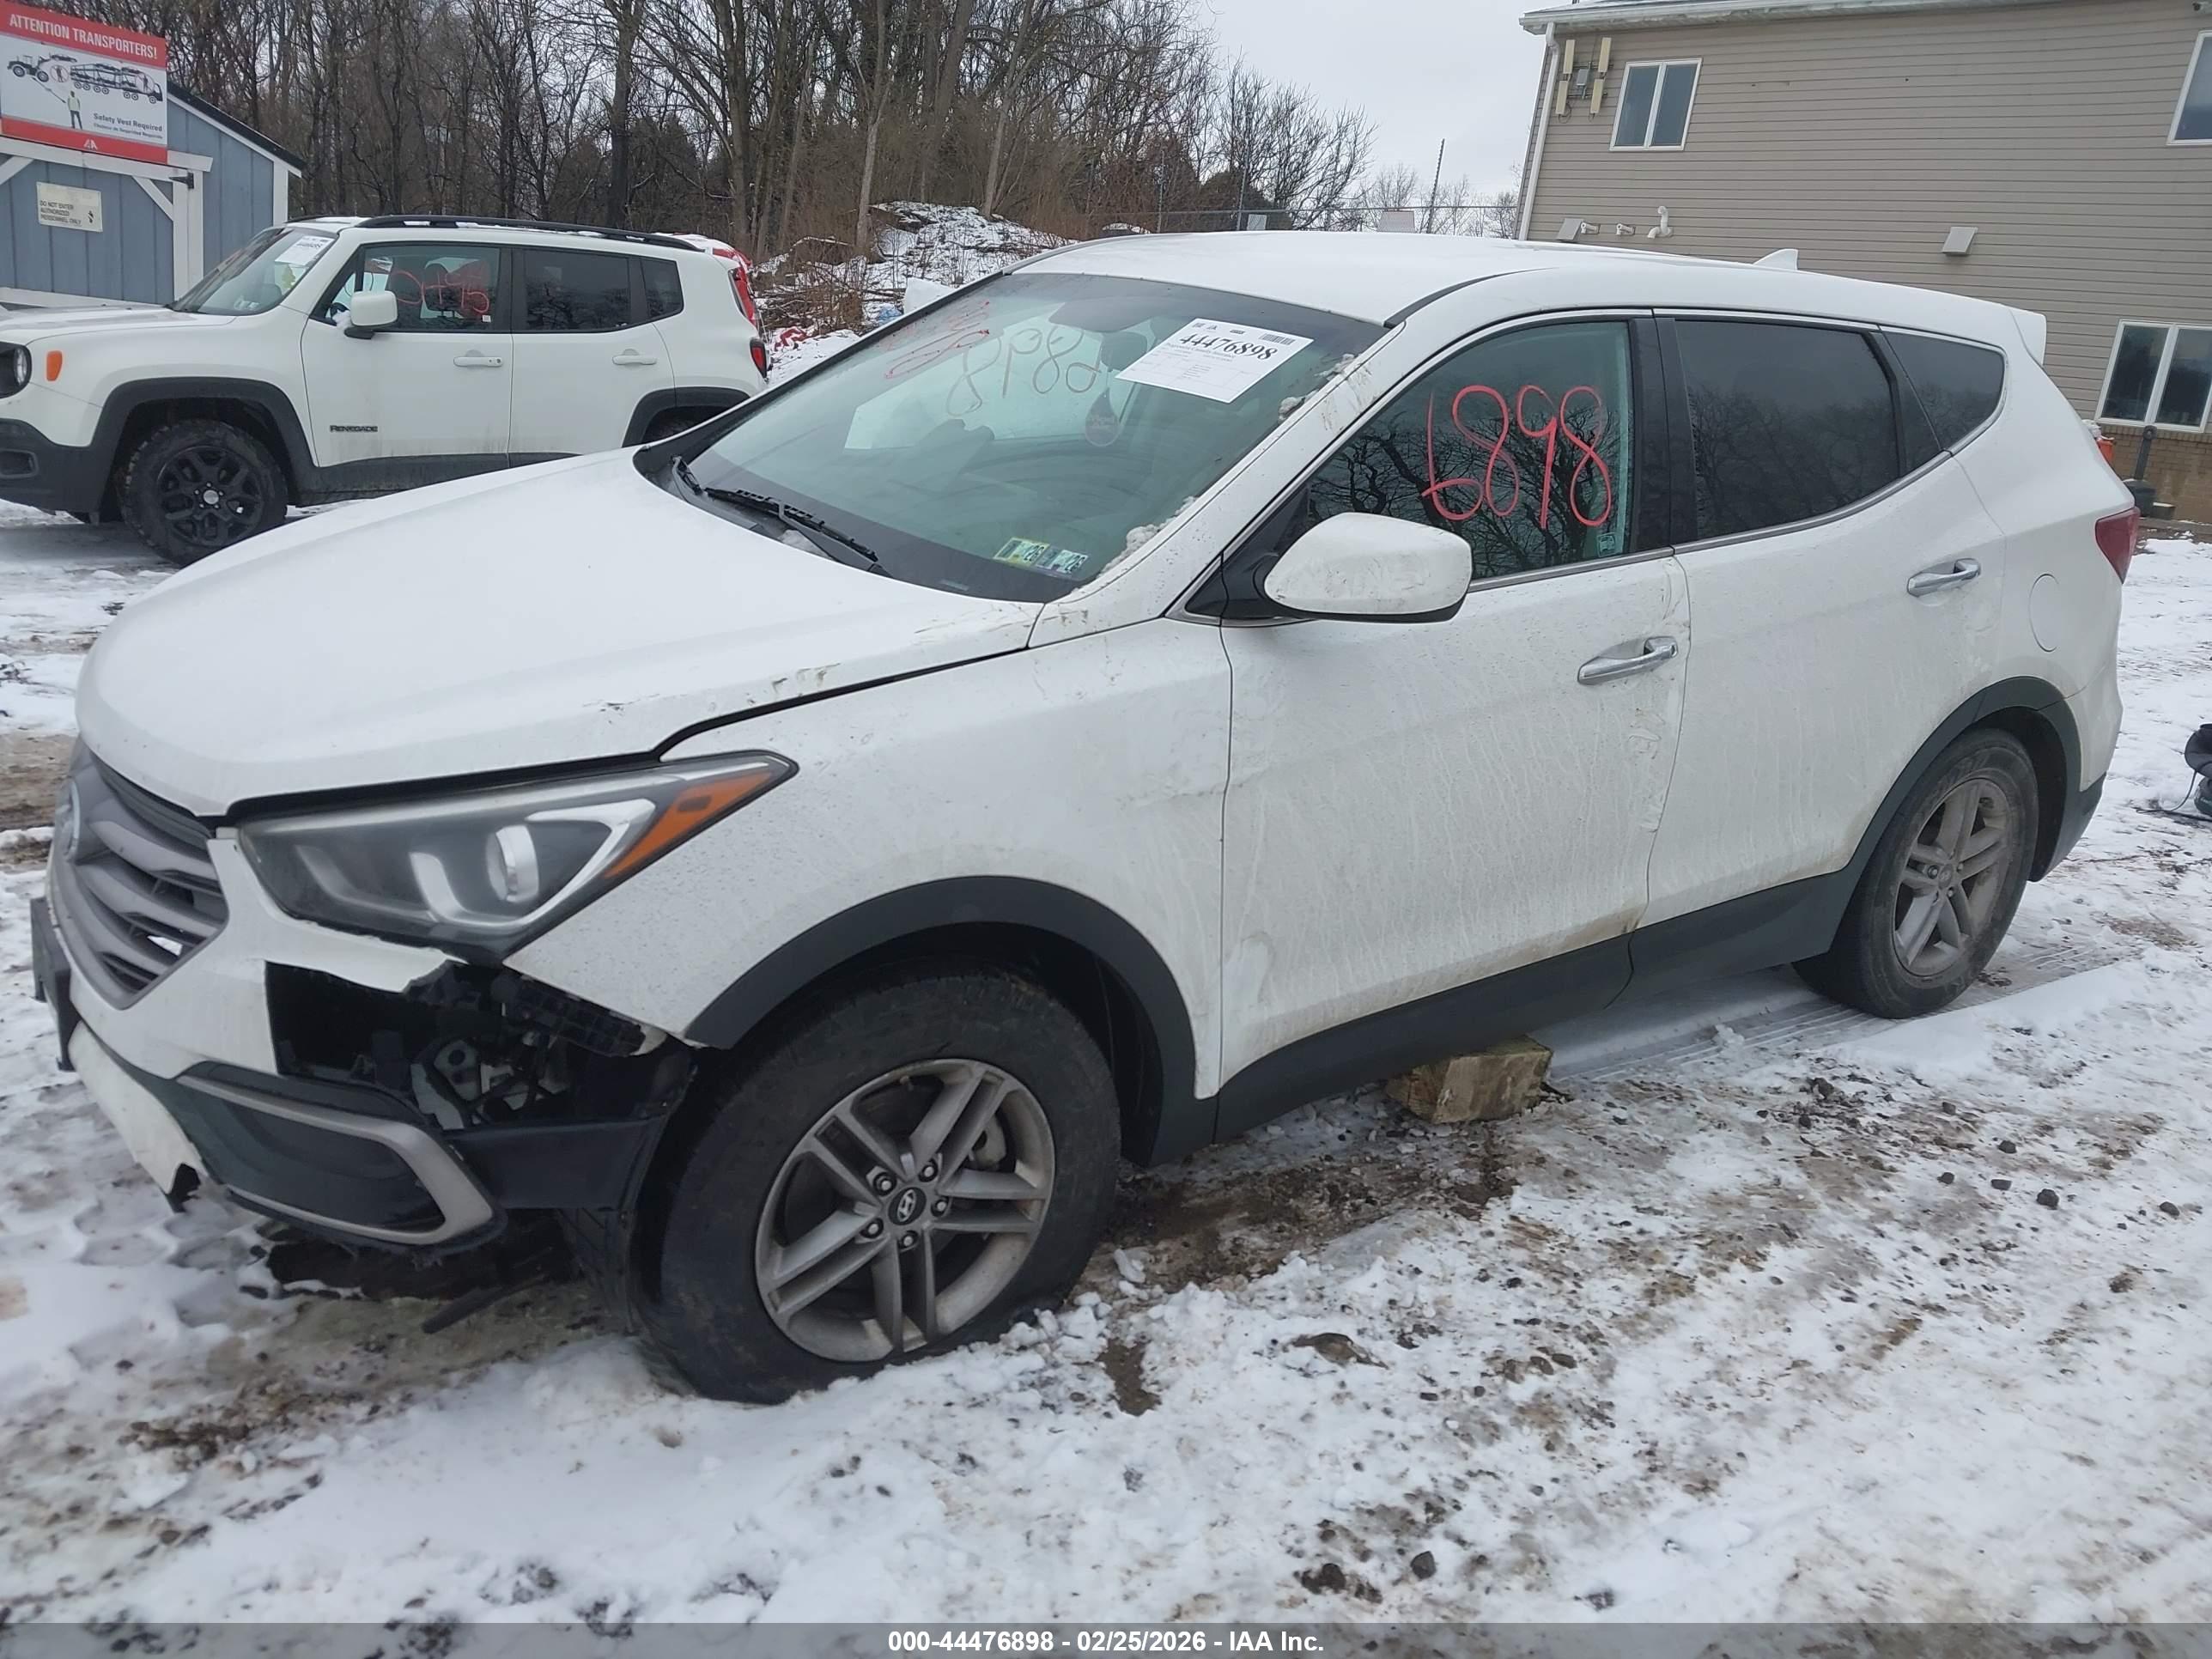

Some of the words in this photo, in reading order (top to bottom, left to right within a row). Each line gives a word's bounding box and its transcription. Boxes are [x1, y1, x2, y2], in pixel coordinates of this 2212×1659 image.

[9, 14, 70, 39] ATTENTION
[72, 27, 157, 59] TRANSPORTERS!
[94, 112, 115, 124] Safety
[133, 120, 162, 131] Required
[1180, 333, 1278, 361] 44476898
[1421, 385, 1612, 529] 6898
